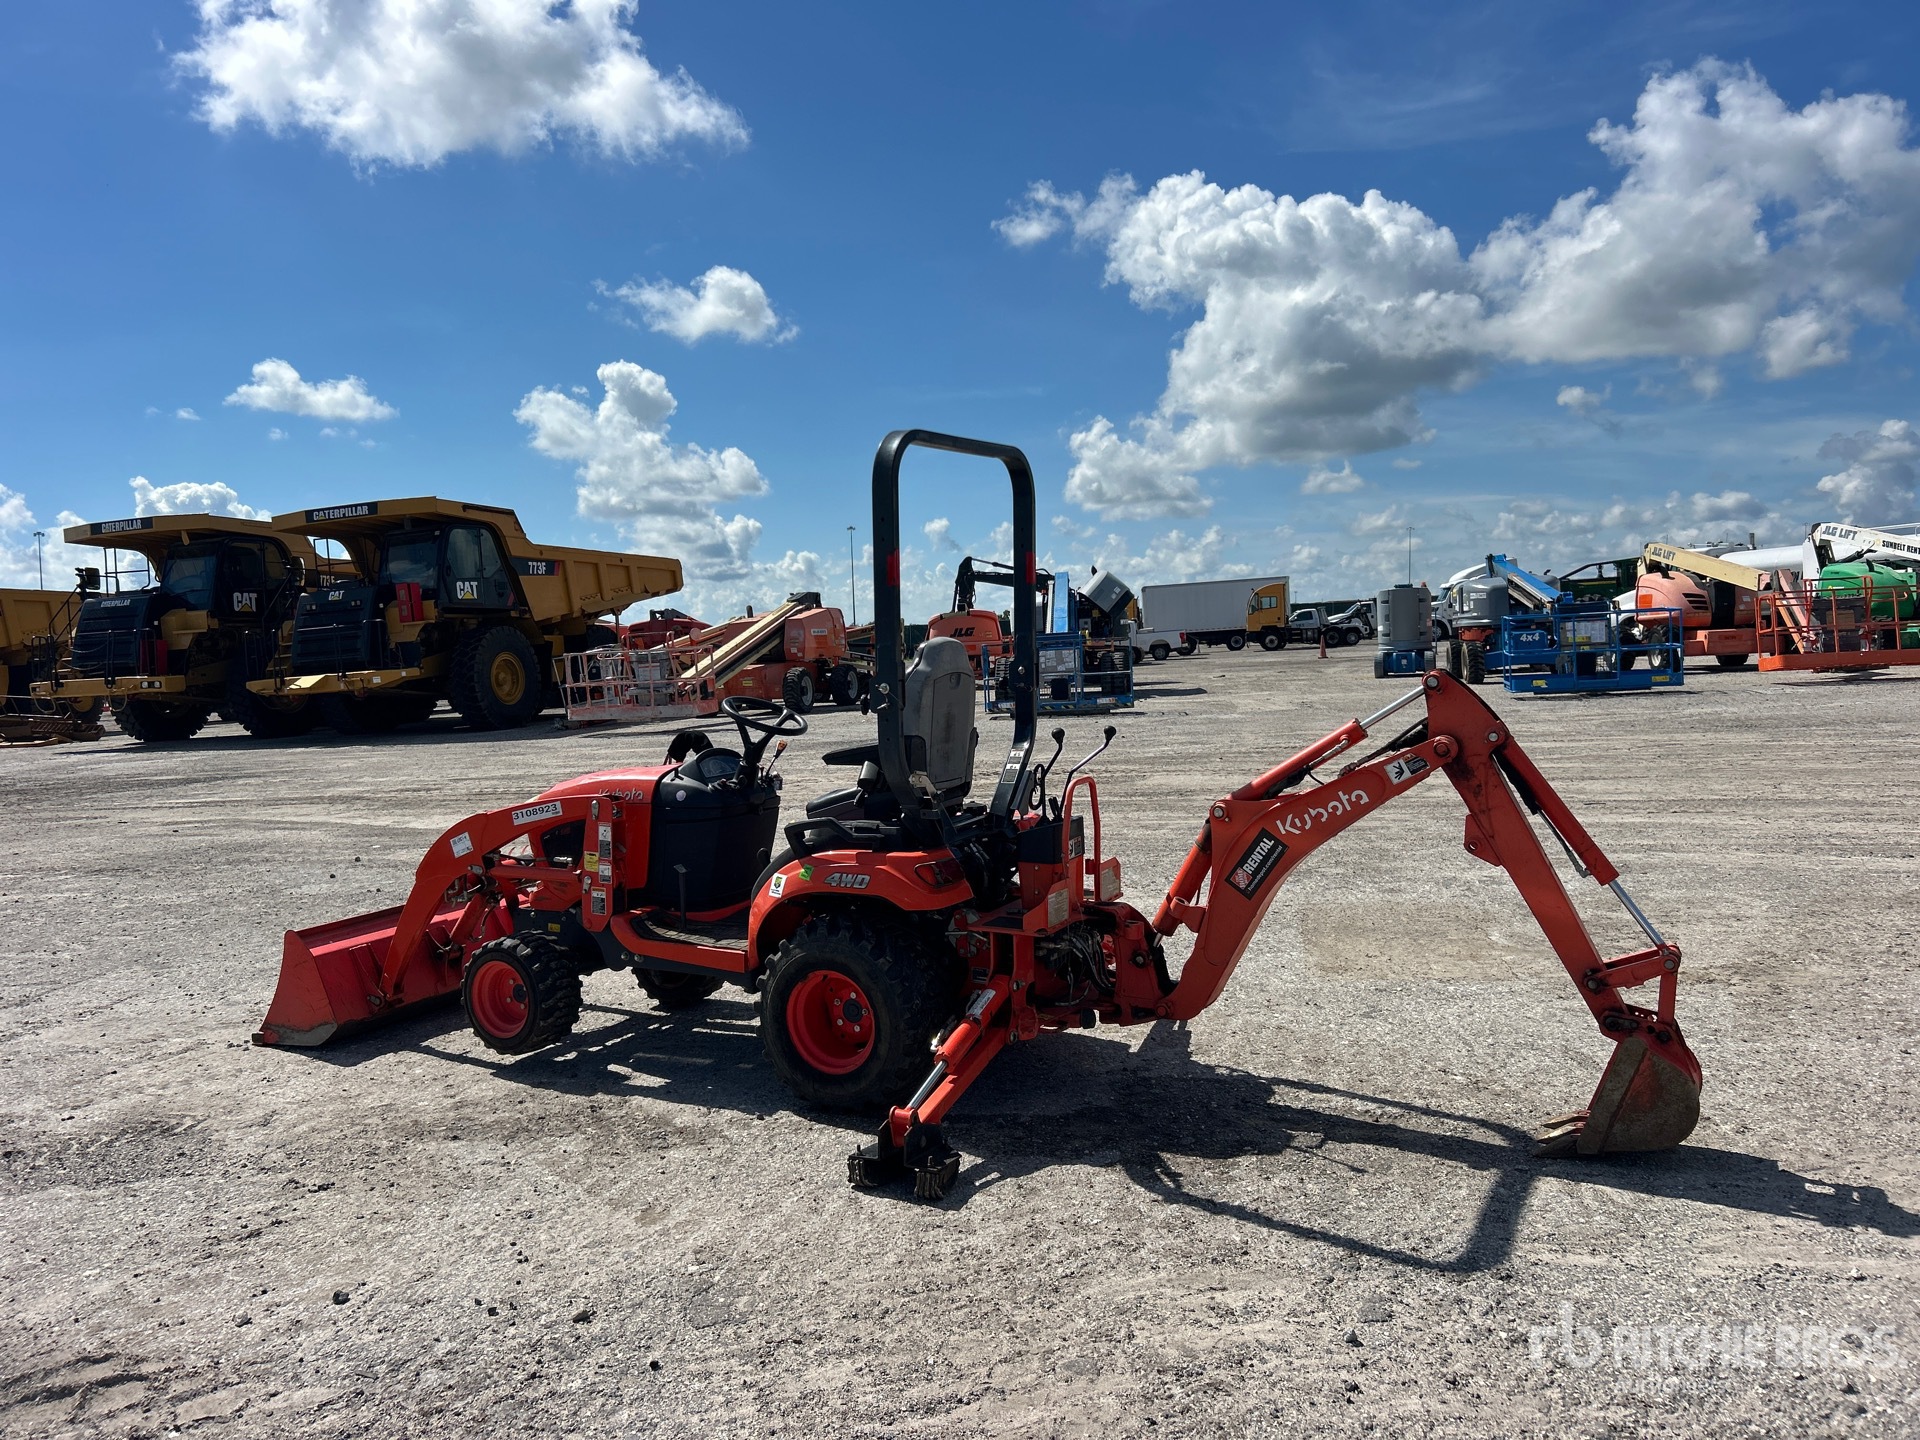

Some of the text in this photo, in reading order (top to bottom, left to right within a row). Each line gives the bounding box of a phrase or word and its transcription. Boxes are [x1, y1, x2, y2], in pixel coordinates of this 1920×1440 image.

[313, 505, 369, 520] CATERPILLAR
[101, 520, 142, 533] CATERPILLAR
[1822, 525, 1858, 541] JLG LIFT
[1881, 539, 1906, 552] SUNBELT
[1651, 546, 1676, 561] JLG LIFT
[527, 561, 547, 575] 773F
[328, 590, 345, 601] CAT
[456, 581, 478, 600] CAT
[100, 599, 131, 608] CATERPILLAR
[233, 592, 258, 612] CAT
[950, 626, 976, 638] JLG
[1520, 632, 1540, 642] 4x4
[512, 803, 558, 820] 3108923
[1275, 789, 1370, 835] Kubota
[1242, 837, 1275, 875] RENTAL
[824, 872, 871, 889] 4WD
